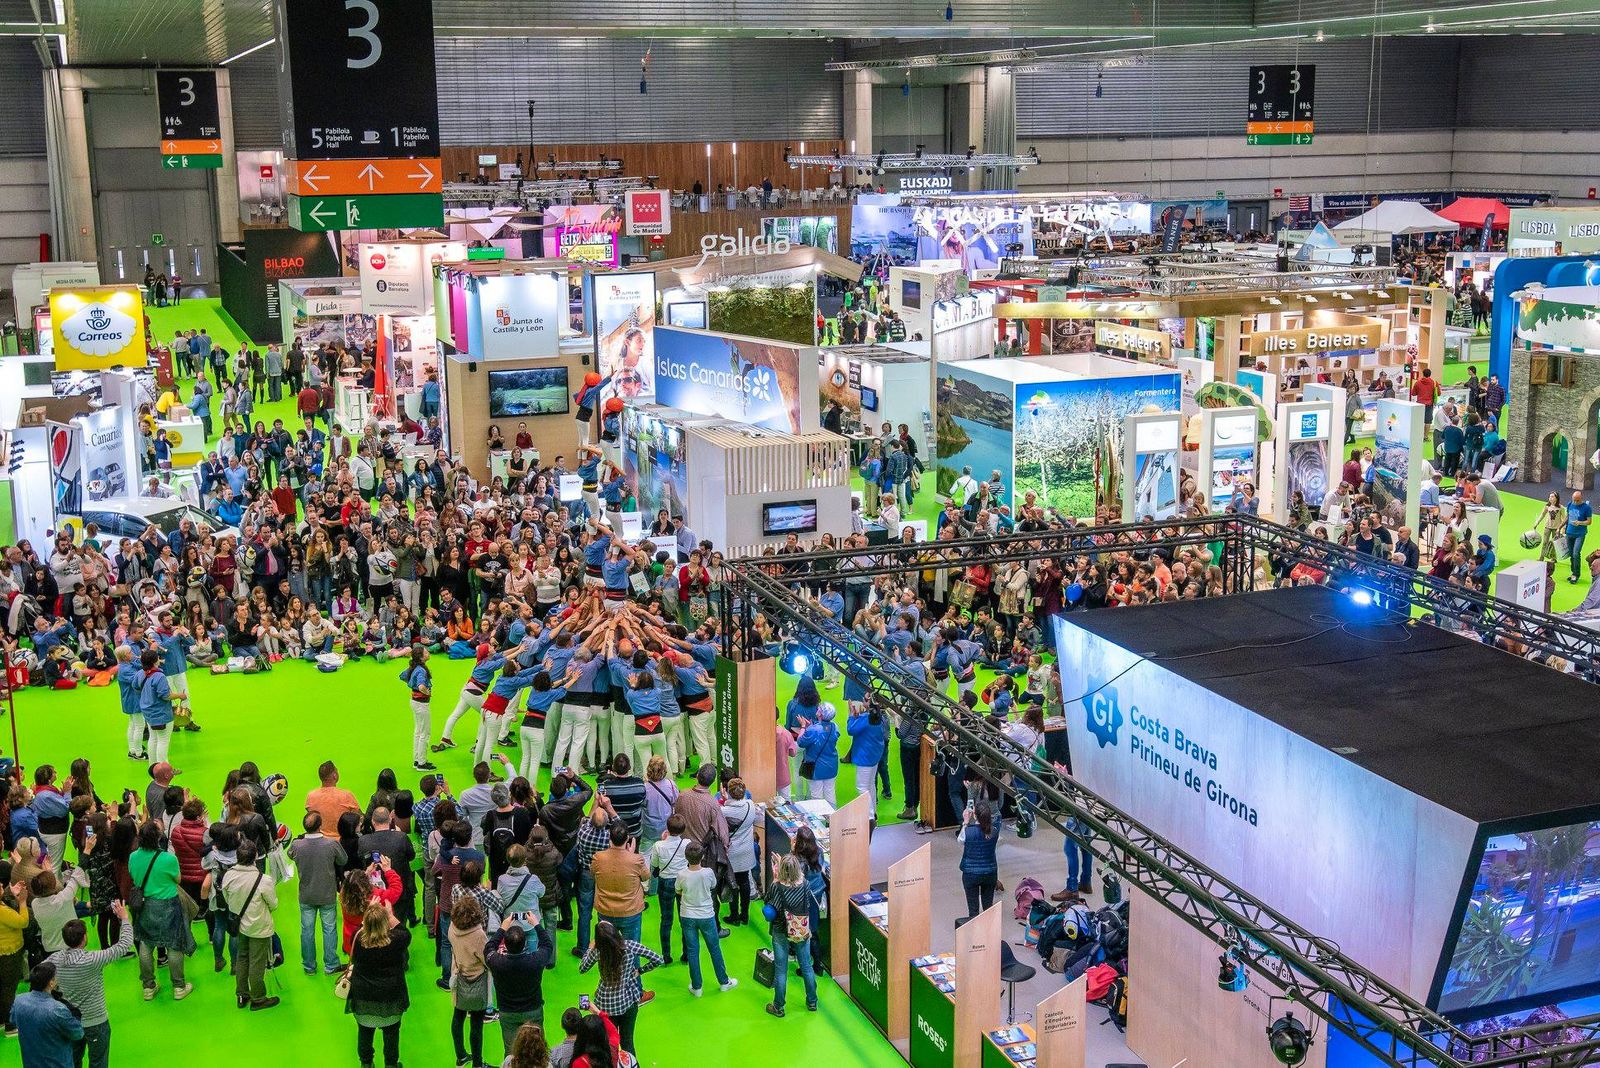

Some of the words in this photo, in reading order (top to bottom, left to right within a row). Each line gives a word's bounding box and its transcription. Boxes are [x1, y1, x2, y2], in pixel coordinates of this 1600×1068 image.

[345, 0, 382, 69] 3
[178, 77, 196, 106] 3
[1257, 71, 1266, 94] 3
[1289, 70, 1301, 94] 3
[200, 127, 205, 136] 1
[311, 128, 323, 148] 5
[390, 127, 399, 147] 1
[900, 177, 952, 188] EUSKADI
[900, 189, 923, 197] BASQUE
[924, 188, 951, 196] COUNTRY
[1520, 220, 1556, 236] LISBOA
[690, 228, 791, 272] galicia
[264, 257, 305, 269] BILBAO
[315, 301, 338, 313] Lleida
[78, 331, 122, 342] Correos
[492, 326, 519, 334] Castilla
[1264, 335, 1298, 352] Illes
[1306, 332, 1369, 349] Balears
[657, 355, 687, 381] Islas
[689, 362, 752, 393] Canarias
[1134, 387, 1176, 397] Formentera
[1091, 692, 1114, 734] G!
[1130, 705, 1169, 744] Costa
[1174, 728, 1217, 771] Brava
[1131, 734, 1179, 781] Pirineu
[1184, 768, 1201, 793] de
[1206, 779, 1258, 828] Girona
